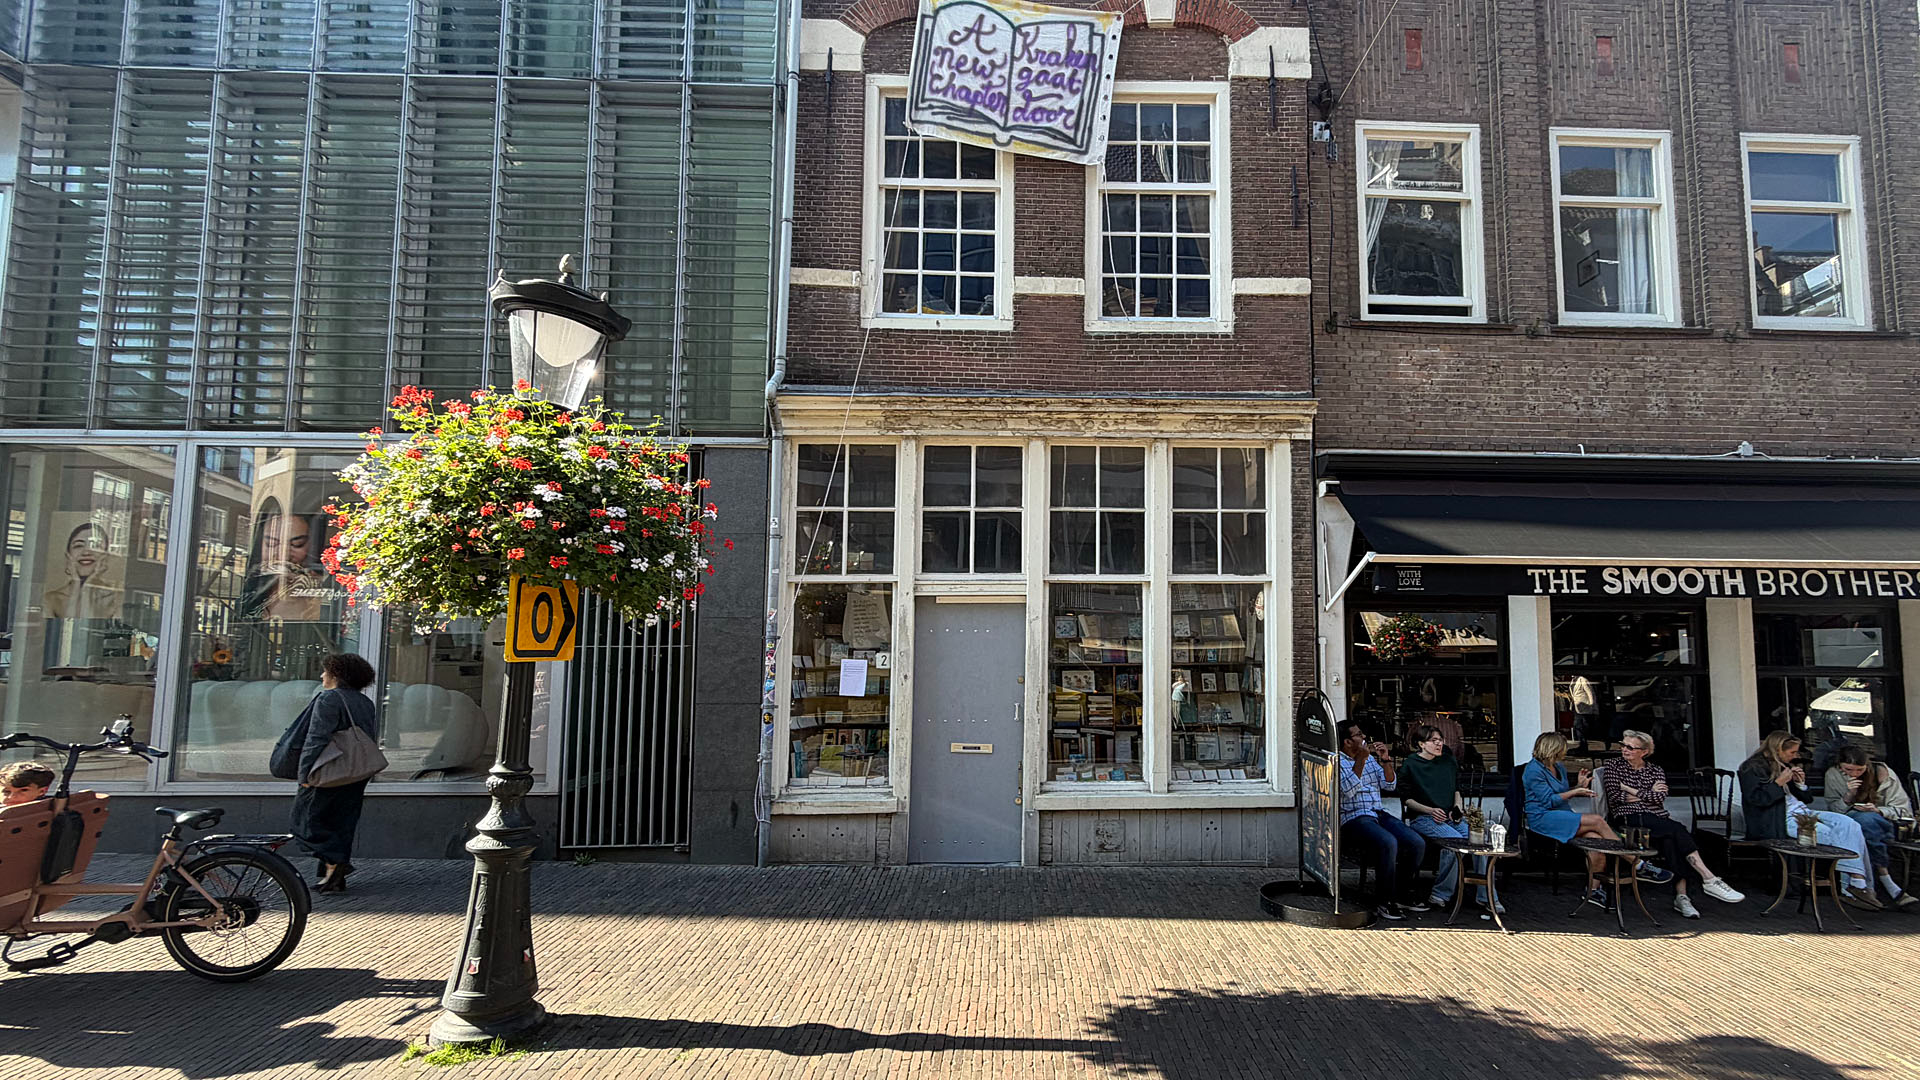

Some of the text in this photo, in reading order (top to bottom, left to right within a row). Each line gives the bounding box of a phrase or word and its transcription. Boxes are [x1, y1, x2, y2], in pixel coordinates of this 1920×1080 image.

[948, 13, 997, 55] A
[1015, 66, 1082, 95] gaat
[1013, 88, 1075, 130] door
[1397, 570, 1422, 578] WITH
[1398, 578, 1422, 586] LOVE
[1527, 567, 1920, 597] THE SMOOTH BROTHER
[881, 654, 888, 666] 2
